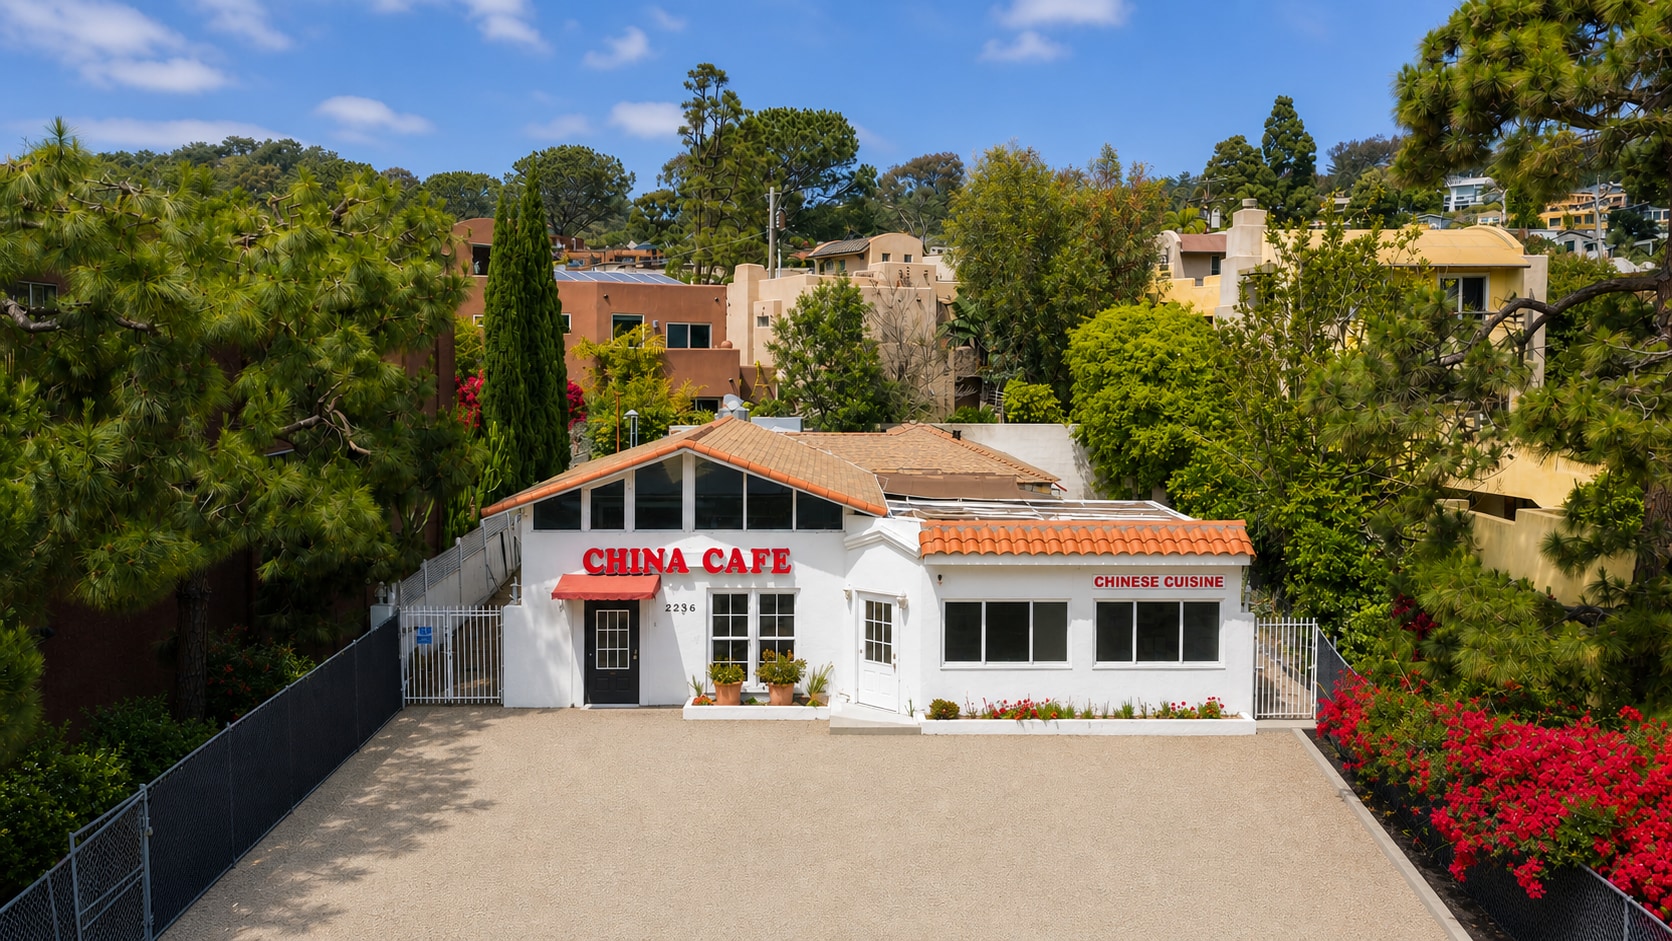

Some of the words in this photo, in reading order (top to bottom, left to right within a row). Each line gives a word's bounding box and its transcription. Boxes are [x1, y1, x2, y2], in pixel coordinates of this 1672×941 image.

[582, 547, 690, 575] CHINA
[702, 547, 792, 575] CAFE
[1094, 575, 1159, 588] CHINESE
[1164, 575, 1224, 588] CUISINE
